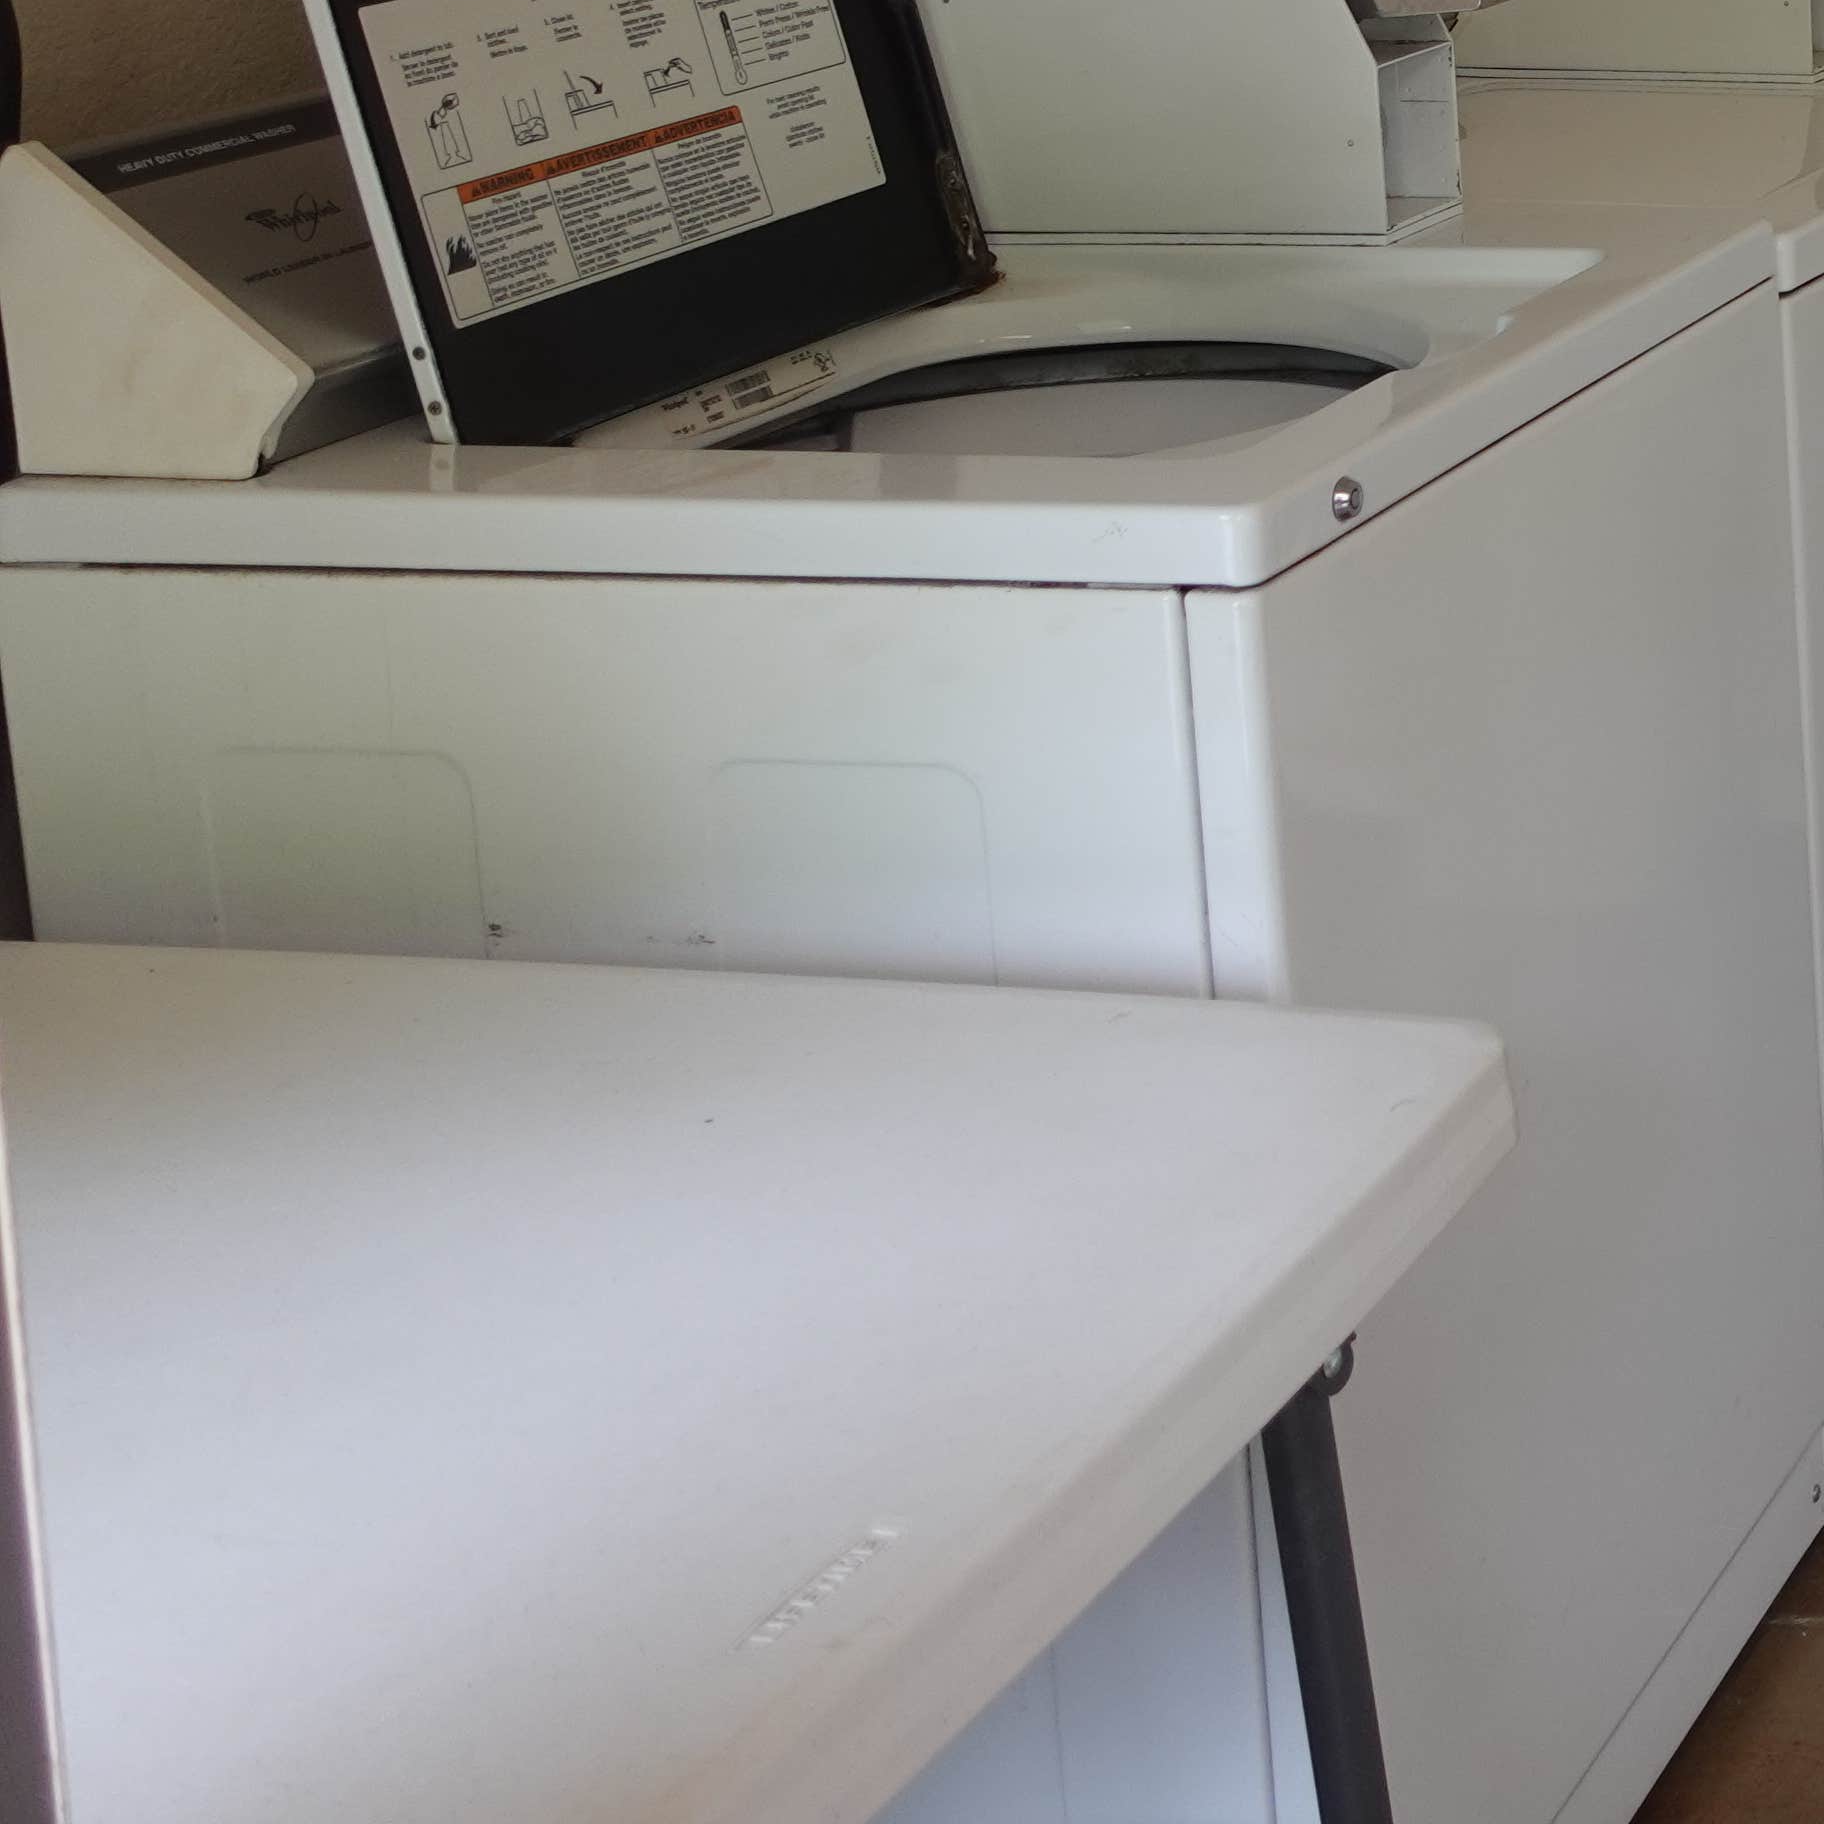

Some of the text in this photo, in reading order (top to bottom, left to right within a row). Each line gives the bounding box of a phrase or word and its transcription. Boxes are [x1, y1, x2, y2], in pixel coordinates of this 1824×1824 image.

[118, 124, 296, 174] HEAVY DUTY COMMERCIAL WASHER
[480, 168, 534, 194] WARNING
[555, 135, 645, 169] AVERTISSEMENT
[664, 111, 735, 139] ADVERTENCIA
